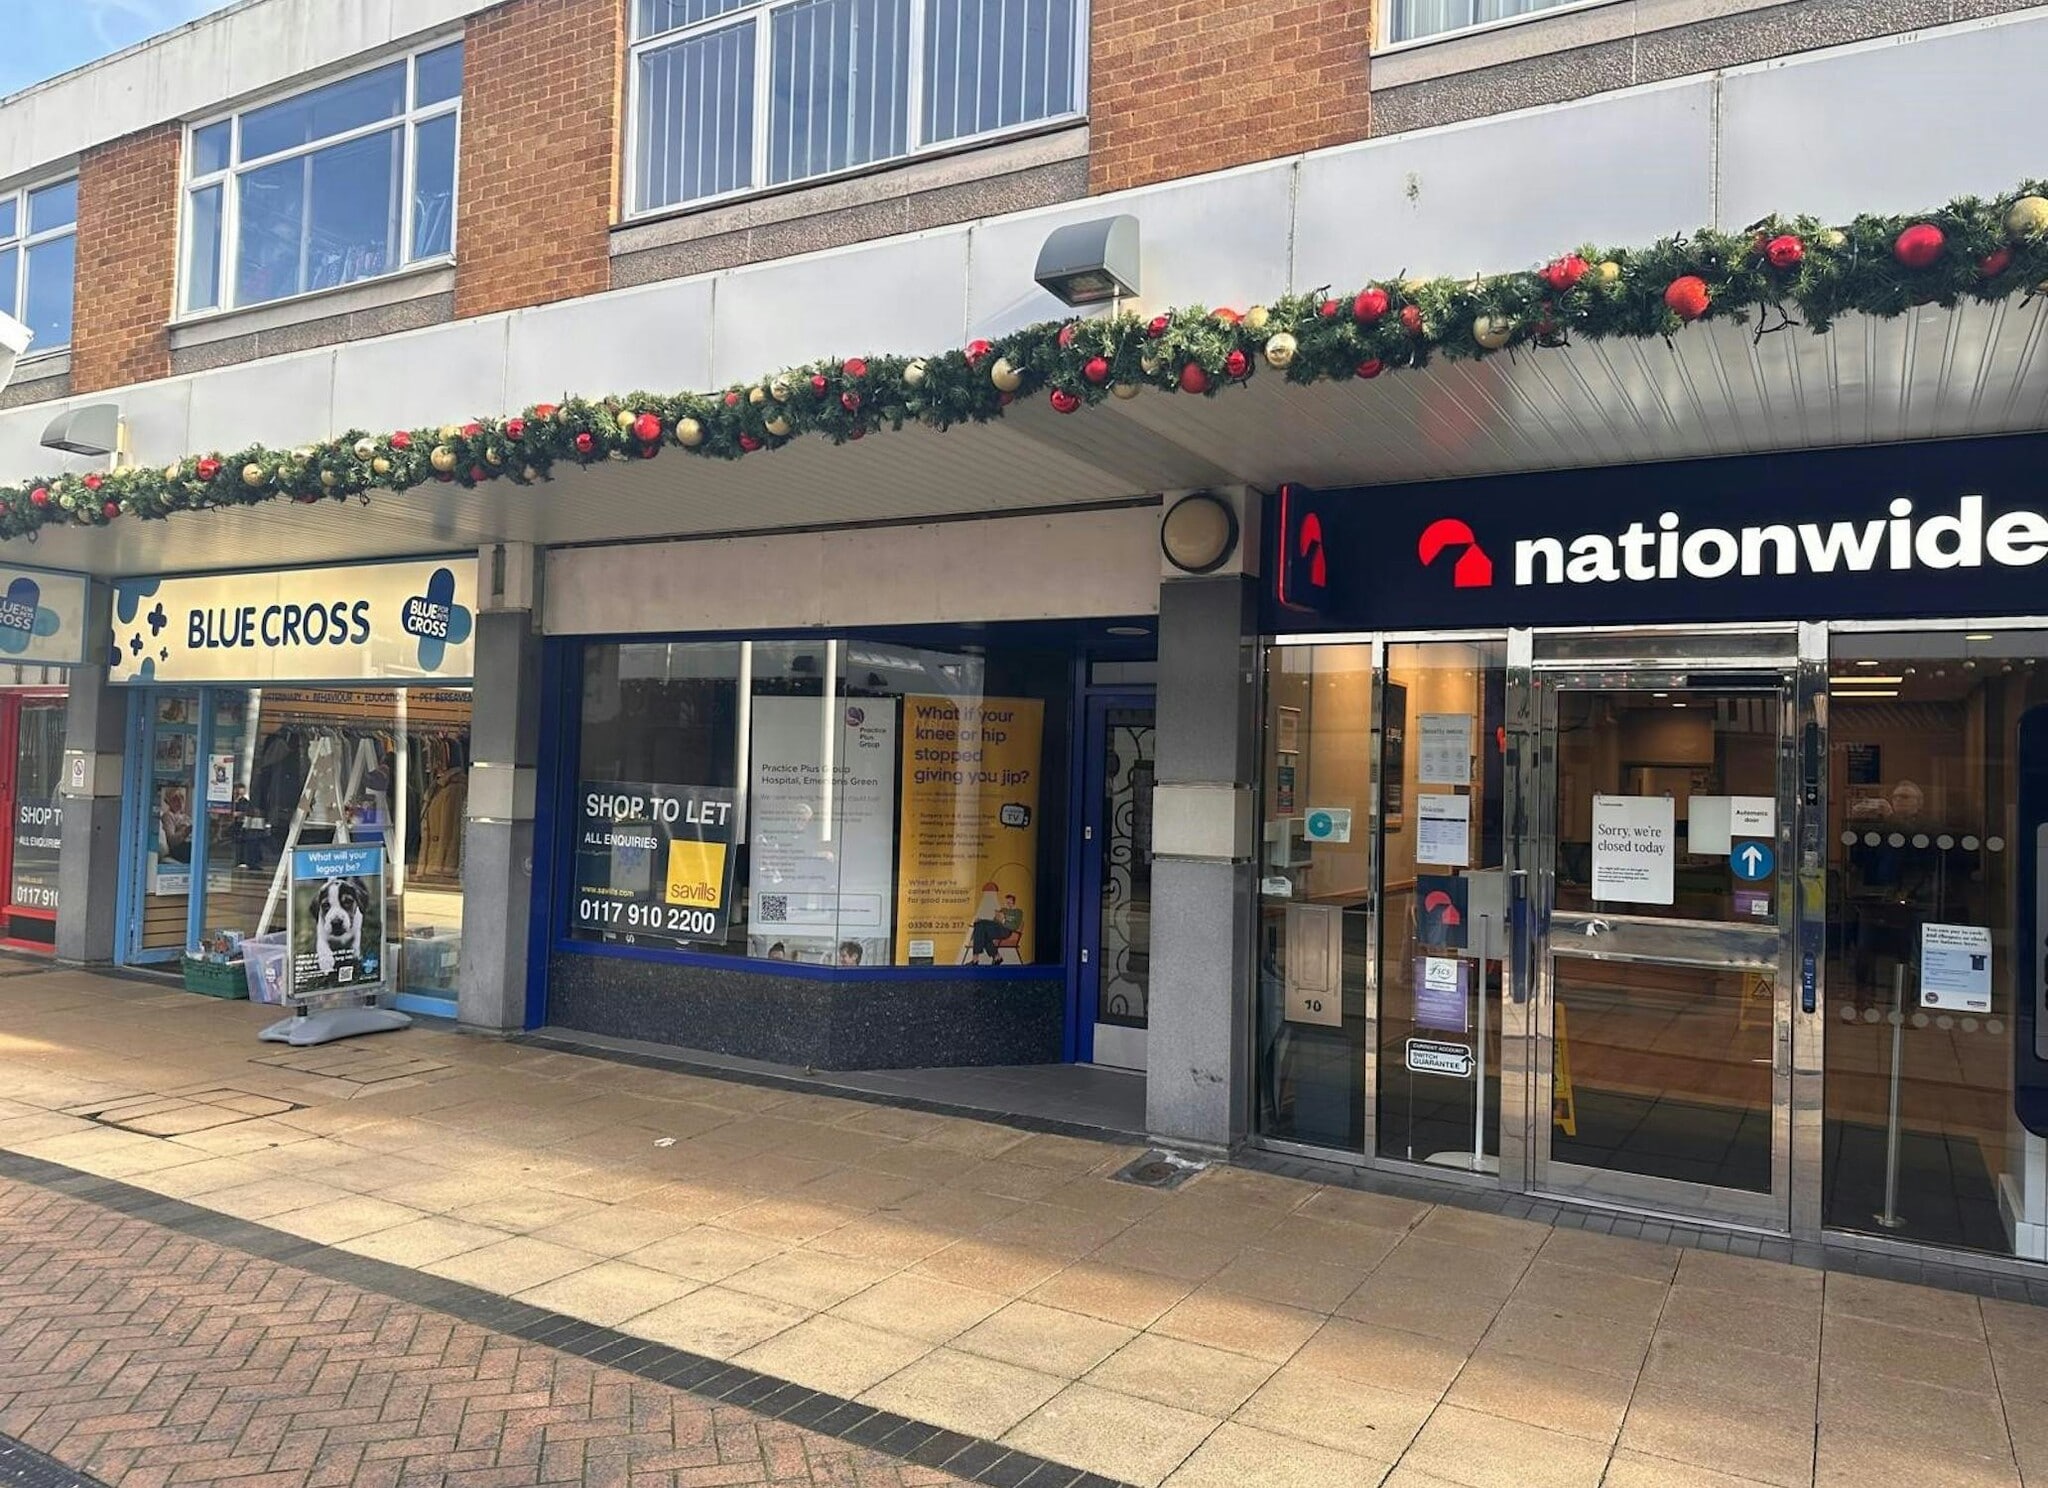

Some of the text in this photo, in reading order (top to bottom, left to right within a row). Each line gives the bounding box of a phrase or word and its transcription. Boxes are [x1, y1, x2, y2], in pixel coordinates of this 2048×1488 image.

[1514, 495, 2048, 586] nationwide
[409, 600, 438, 620] BLUE
[188, 600, 370, 648] BLUE CROSS
[407, 616, 447, 638] CROSS
[916, 705, 1014, 724] What if your
[915, 725, 1007, 745] knee or hip
[915, 748, 983, 764] stopped
[762, 763, 798, 773] Practice
[800, 764, 820, 773] Plus
[914, 768, 1030, 786] giving you jip?
[762, 777, 801, 787] Hospital,
[850, 777, 878, 786] Green
[21, 806, 51, 825] SHOP
[586, 793, 644, 819] SHOP
[650, 797, 680, 823] TO
[685, 800, 732, 826] LET
[1735, 809, 1768, 817] Automatic
[1597, 823, 1662, 838] Sorry, we're
[584, 832, 658, 850] ALL ENQUIRIES
[1597, 839, 1665, 856] closed today
[308, 850, 368, 862] What will your
[17, 886, 40, 905] 0117
[671, 882, 716, 902] savills
[580, 899, 715, 935] 0117 910 2200
[1412, 1042, 1465, 1054] CURRENT ACCOUNT
[1413, 1052, 1438, 1060] SWITCH
[1413, 1057, 1460, 1069] GUARANTEE
